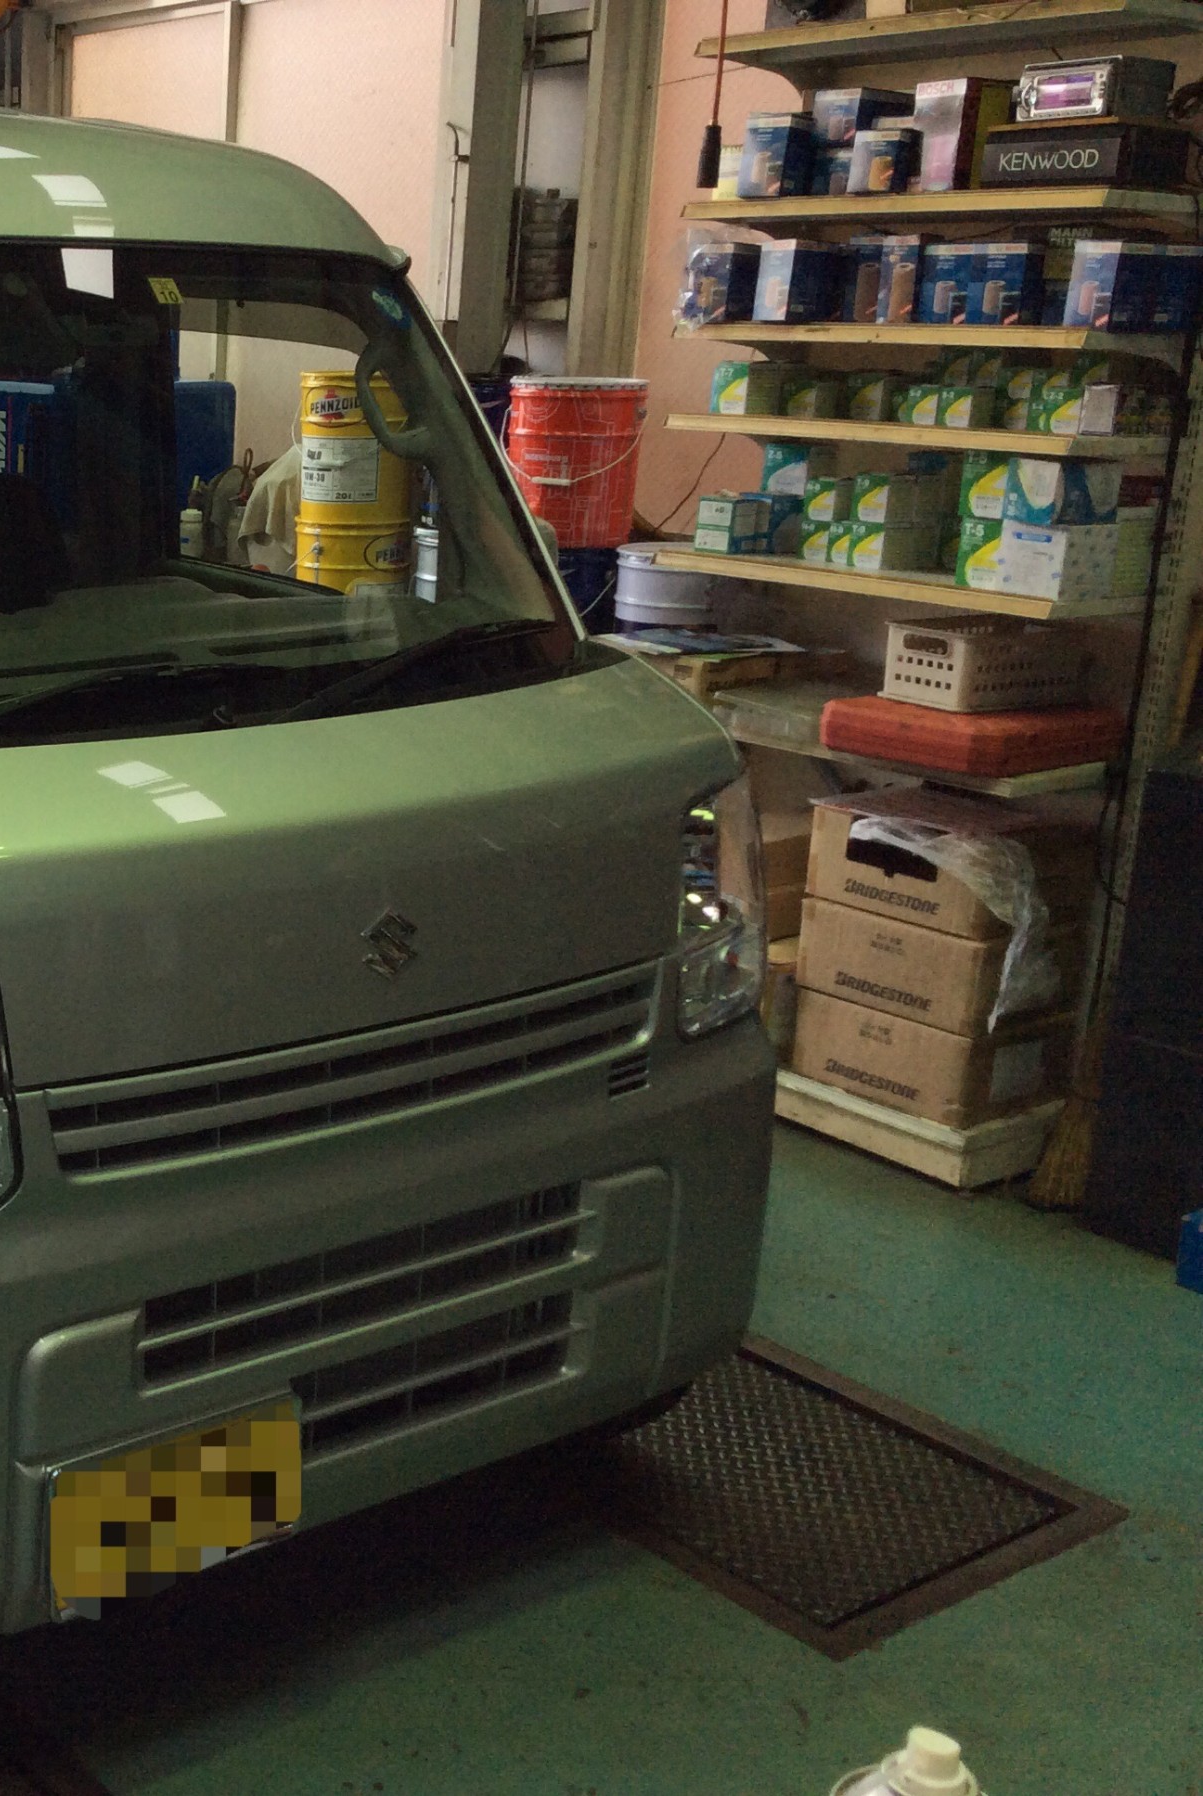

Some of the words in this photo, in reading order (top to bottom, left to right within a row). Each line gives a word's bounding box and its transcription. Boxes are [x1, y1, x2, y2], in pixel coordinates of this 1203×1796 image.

[917, 81, 954, 96] BOSCH
[998, 148, 1099, 171] KENWOOD
[159, 290, 179, 303] 10
[310, 397, 359, 414] PENNZOIL
[844, 878, 940, 915] BRIDGESTONE
[834, 971, 932, 1012] BRIDGESTONE
[824, 1058, 920, 1100] BRIDGESTONE
